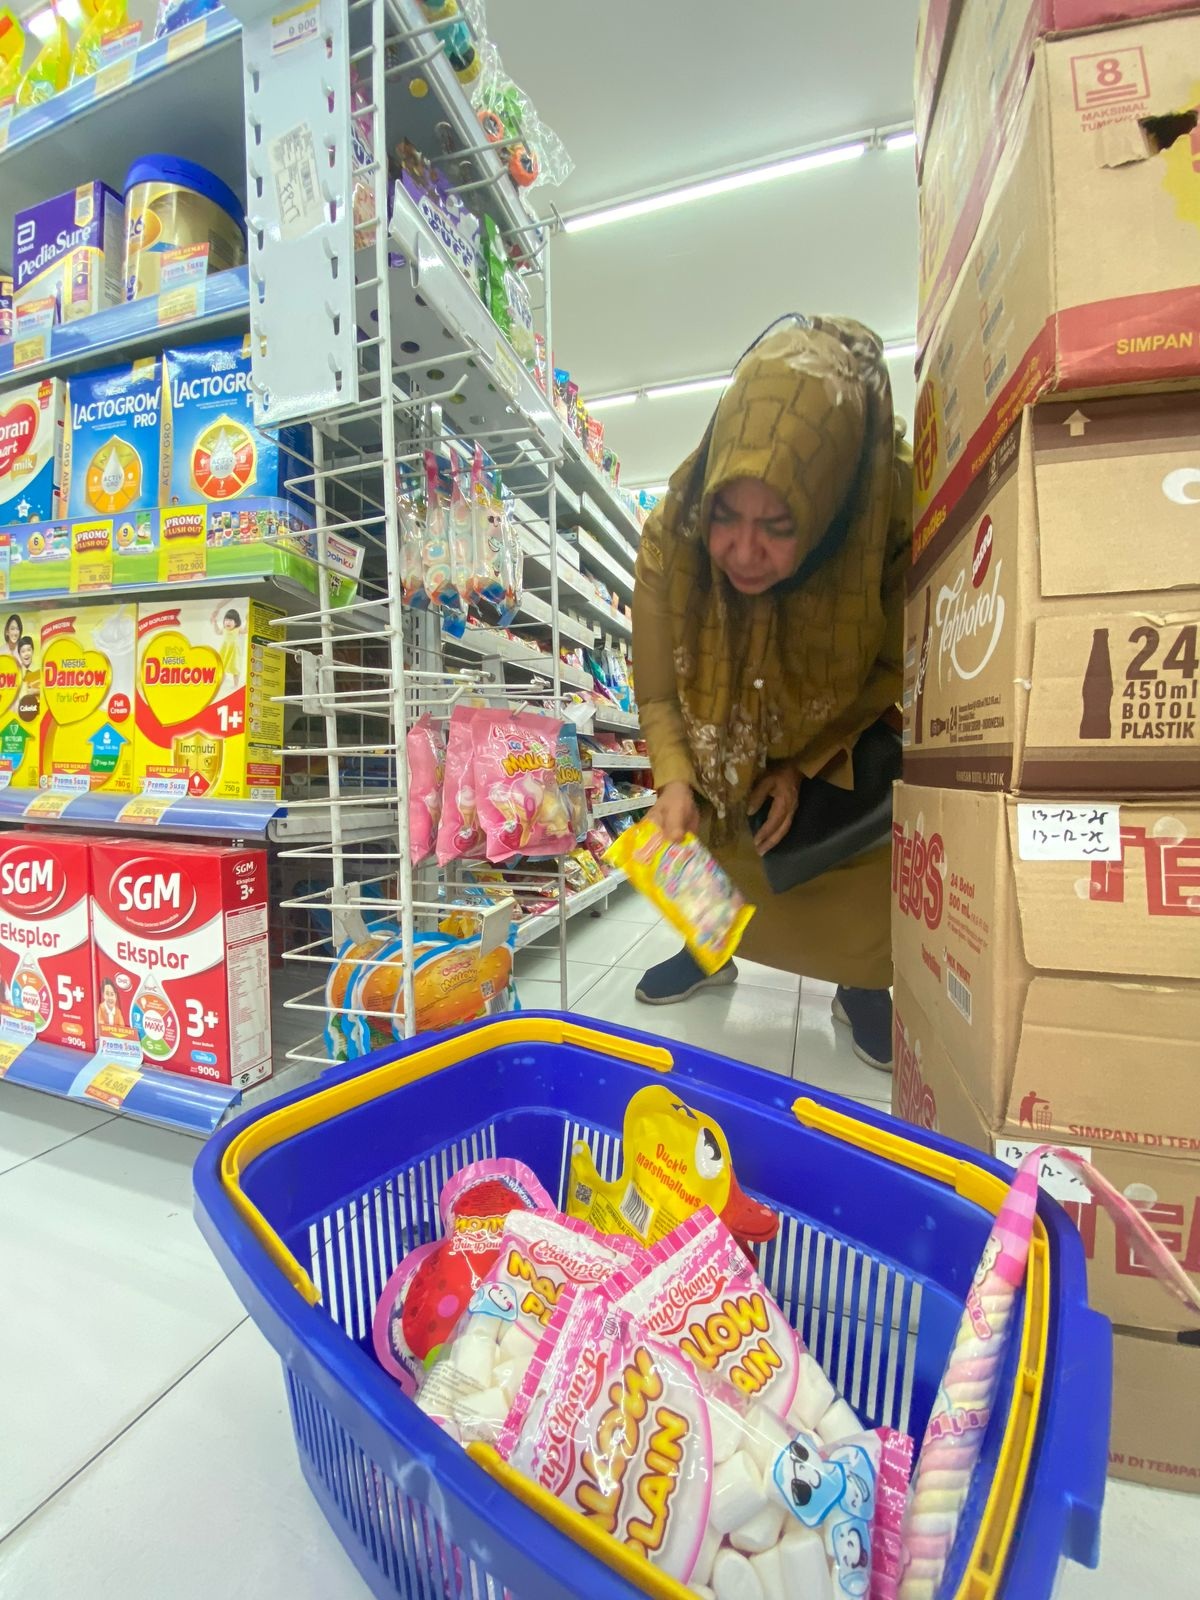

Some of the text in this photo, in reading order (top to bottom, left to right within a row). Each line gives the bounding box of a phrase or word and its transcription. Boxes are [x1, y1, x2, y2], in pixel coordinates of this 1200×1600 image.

[1096, 58, 1122, 86] 8
[1081, 102, 1148, 122] MAKSIMAL
[18, 225, 92, 285] PediaSure
[1116, 332, 1193, 355] SIMPAN
[73, 385, 162, 431] LACTOGROW
[133, 412, 157, 429] PRO
[13, 458, 34, 472] milk
[123, 527, 129, 537] 9
[165, 515, 203, 528] PROMO
[187, 525, 202, 533] OUT
[34, 537, 39, 546] 6
[76, 530, 109, 541] PROMO
[96, 539, 109, 548] OUT
[935, 557, 1005, 692] Tehbotol
[1126, 624, 1199, 680] 24
[44, 660, 108, 688] Dancow
[145, 657, 217, 685] Dancow
[110, 707, 128, 715] Cream
[217, 704, 244, 732] 1+
[1122, 701, 1197, 720] BOTOL
[1121, 721, 1196, 740] PLASTIK
[147, 781, 186, 790] Promo Susu
[224, 784, 235, 792] 750
[1, 859, 54, 895] SGM
[236, 861, 254, 875] SGM
[893, 821, 944, 931] TEBS
[118, 872, 181, 911] SGM
[241, 884, 255, 900] 3+
[0, 921, 61, 949] Eksplor
[117, 941, 189, 970] Eksplor
[57, 974, 85, 1011] 5+
[185, 998, 219, 1038] 3+
[67, 1036, 86, 1049] 900g
[102, 1040, 123, 1051] Promo
[197, 1065, 220, 1080] 900g
[1068, 1124, 1139, 1144] SIMPAN
[1143, 1133, 1163, 1147] DI
[655, 1142, 688, 1175] Duckie
[635, 1151, 702, 1208] Marshmallows
[576, 1345, 664, 1530] LLOW
[1128, 1455, 1200, 1478] DI TEMPA
